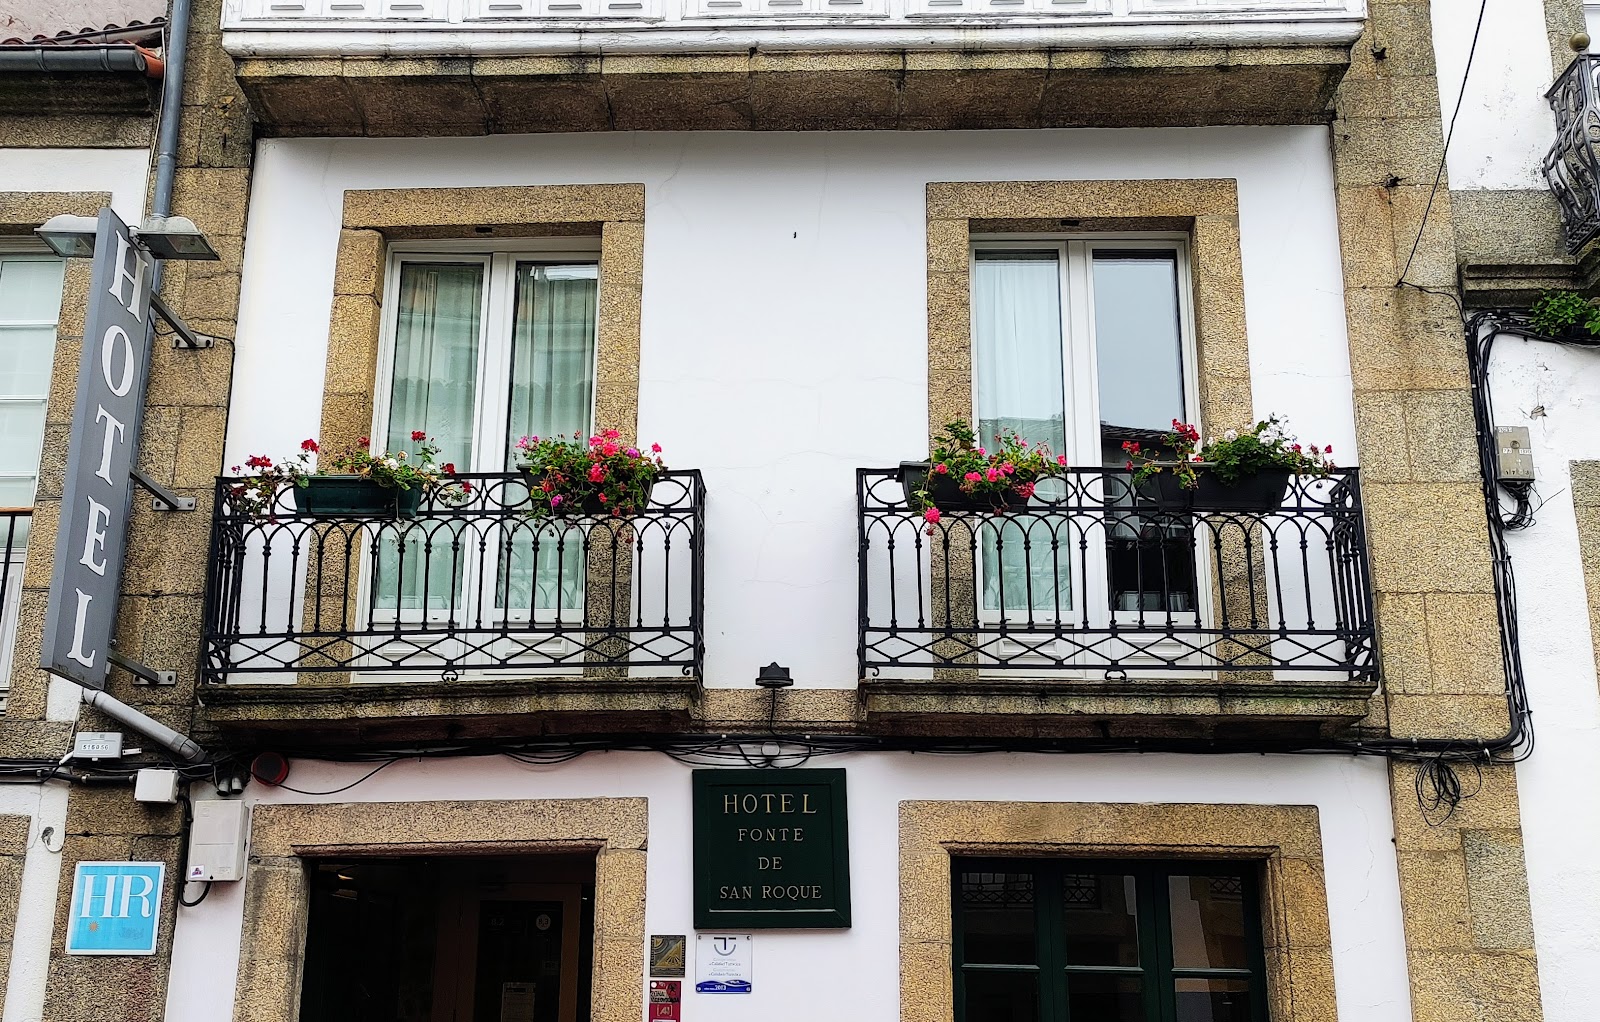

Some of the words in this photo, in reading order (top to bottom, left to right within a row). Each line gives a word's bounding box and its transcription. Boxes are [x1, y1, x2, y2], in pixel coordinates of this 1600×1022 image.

[67, 228, 148, 668] HOTEL
[723, 793, 817, 814] HOTEL
[738, 828, 804, 841] FONTE
[758, 856, 783, 870] DE
[79, 874, 154, 919] HR
[720, 885, 752, 899] SAN
[761, 885, 822, 900] ROQUE
